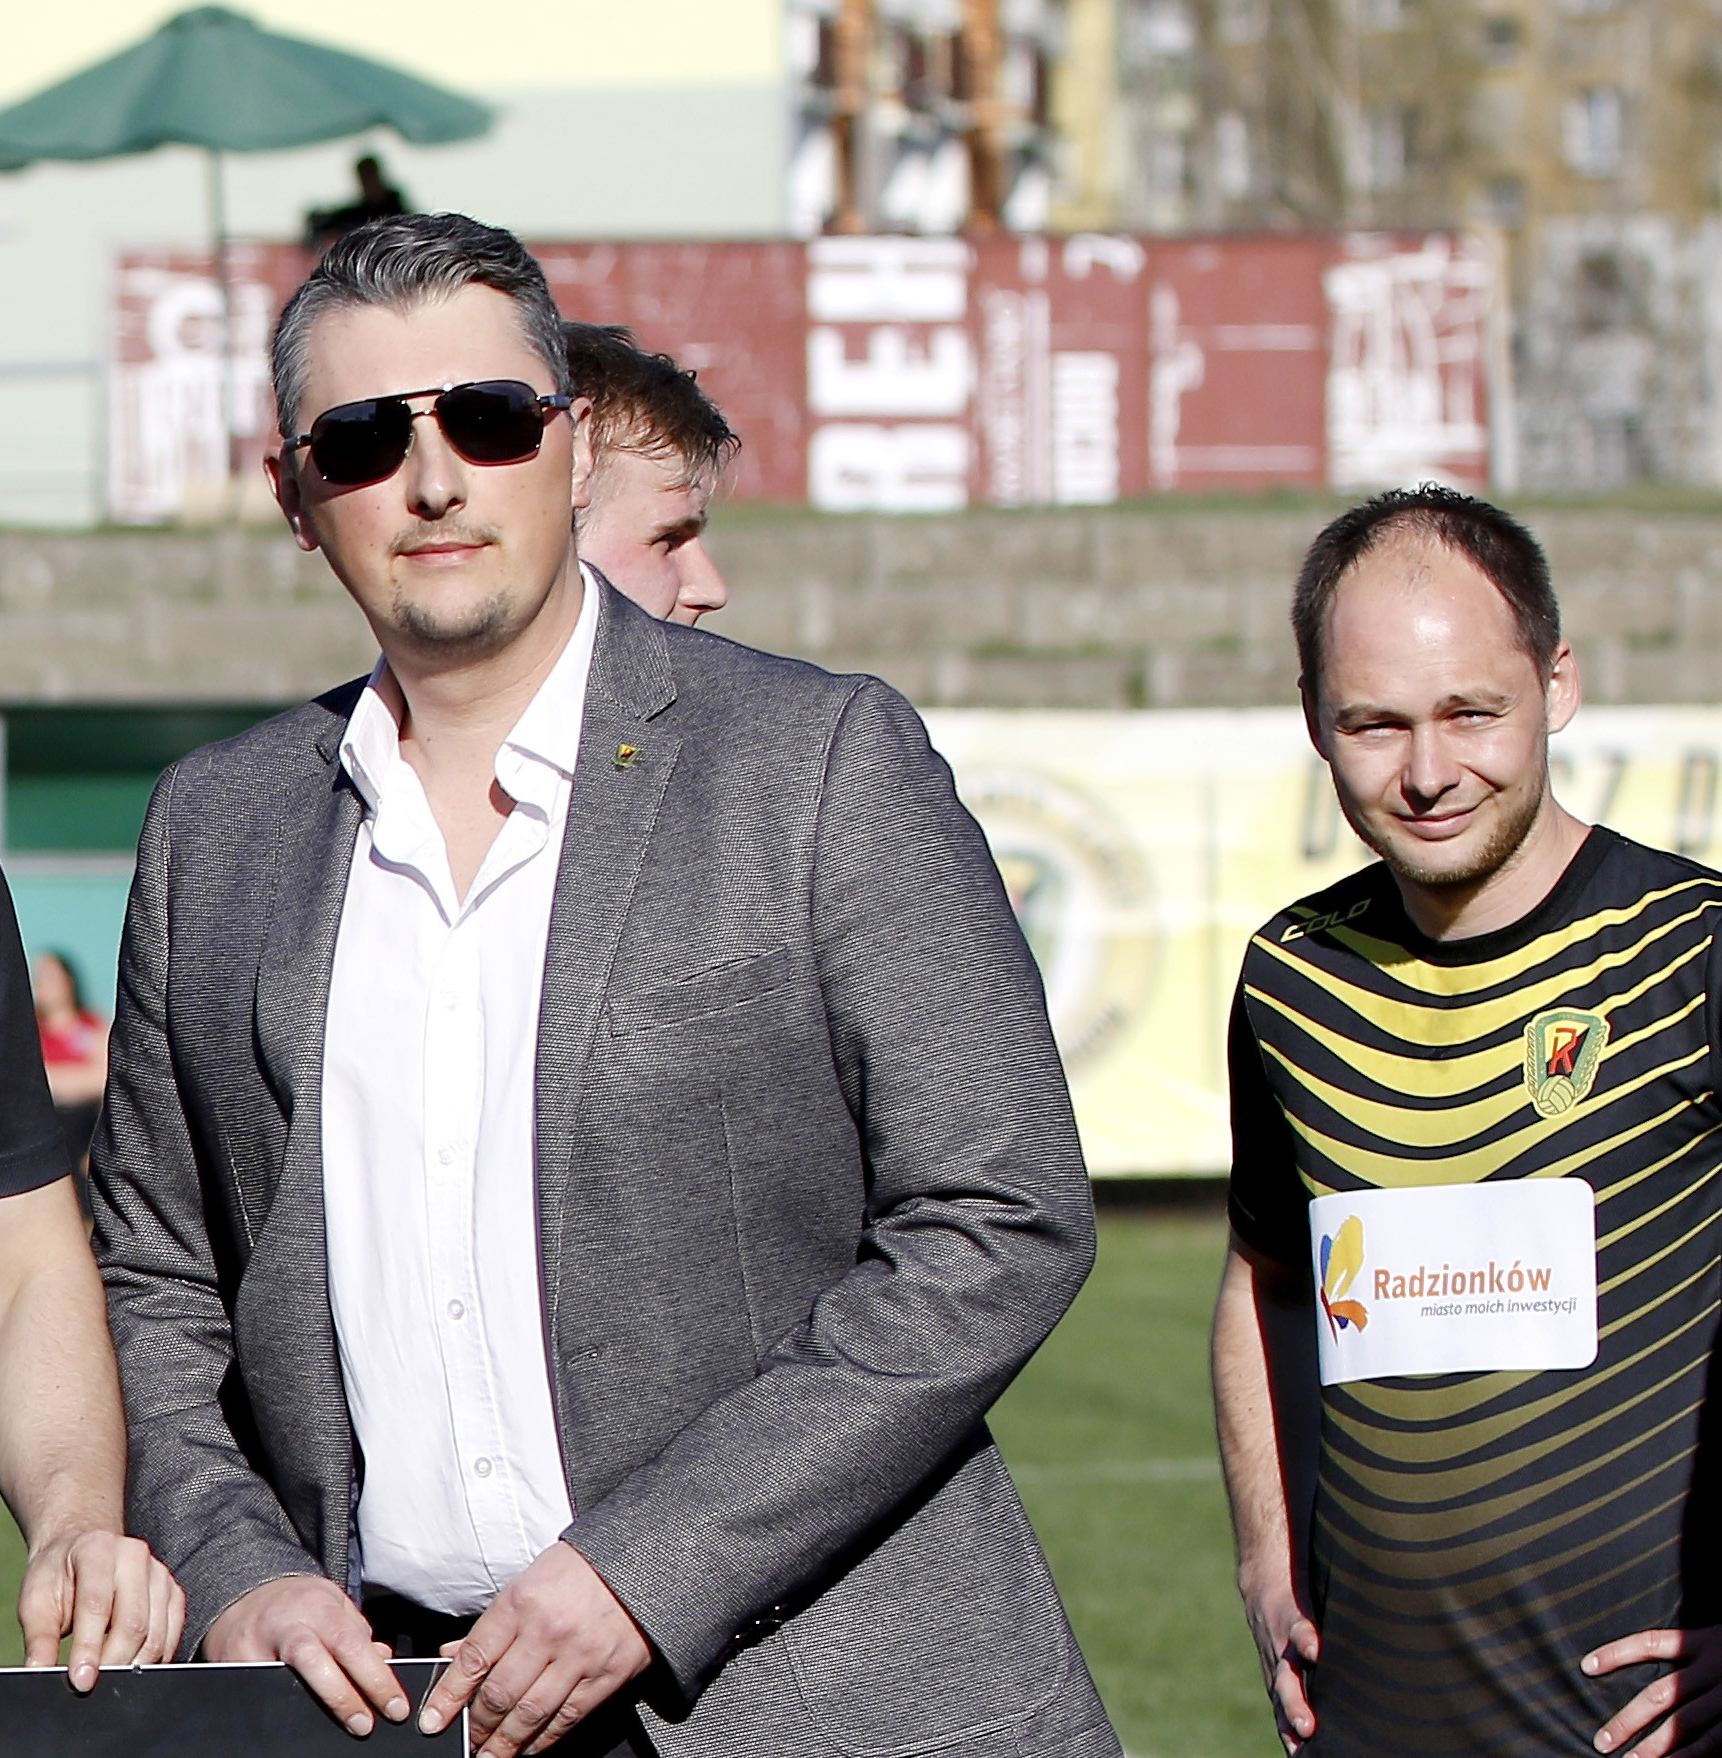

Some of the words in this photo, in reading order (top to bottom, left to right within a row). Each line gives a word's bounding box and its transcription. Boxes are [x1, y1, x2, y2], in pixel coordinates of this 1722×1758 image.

[1280, 898, 1372, 942] COLO
[1374, 1260, 1552, 1300] Radzionków
[1421, 1301, 1462, 1317] miasto
[1465, 1300, 1504, 1316] moich
[1507, 1297, 1577, 1315] inwestycji
